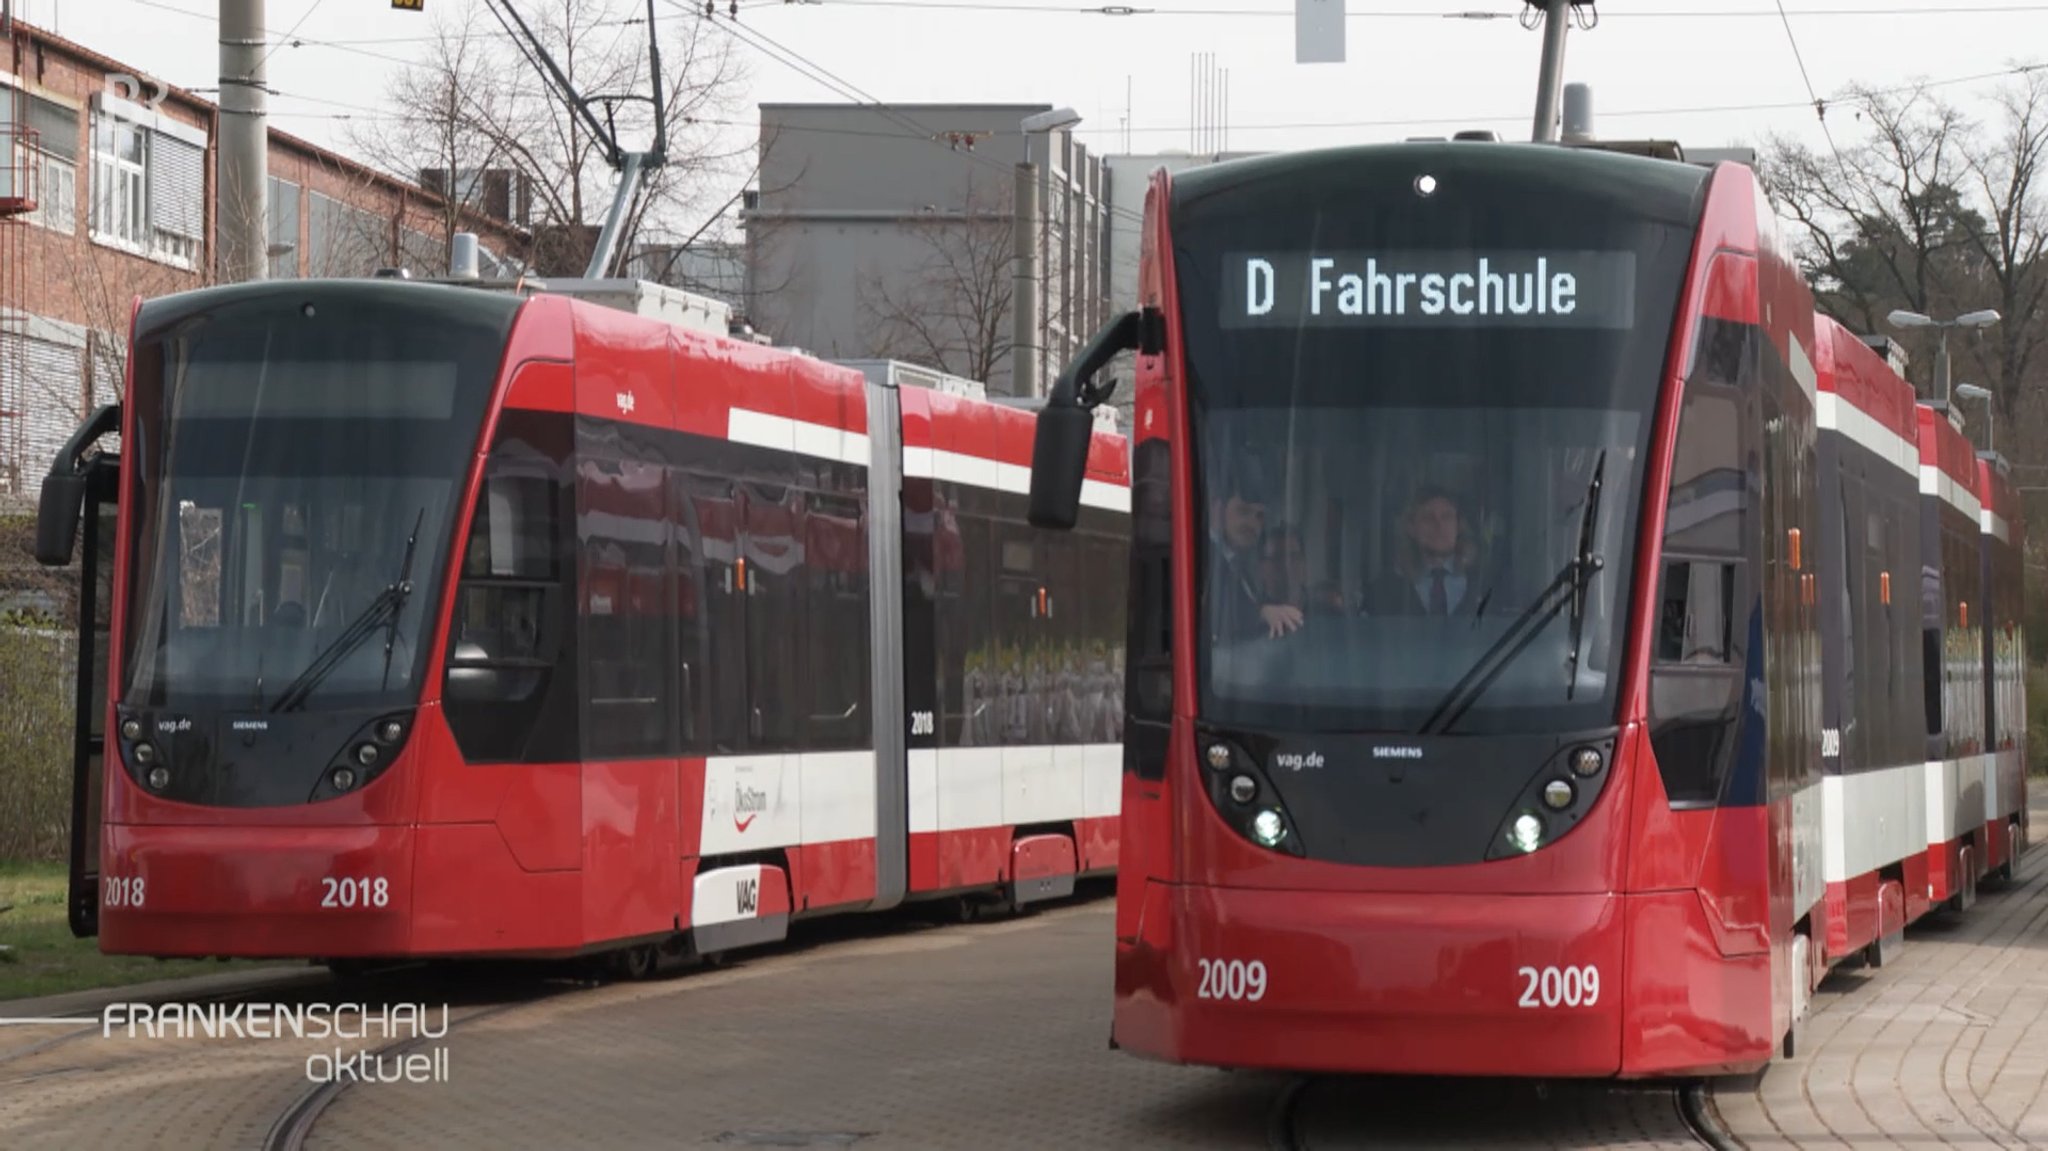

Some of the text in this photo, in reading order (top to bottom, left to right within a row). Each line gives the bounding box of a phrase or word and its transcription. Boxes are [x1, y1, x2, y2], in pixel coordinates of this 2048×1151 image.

[1247, 256, 1576, 315] D Fahrschule
[159, 717, 192, 733] vag.de
[232, 720, 268, 730] SIEMENS
[911, 710, 934, 735] 2018
[1372, 746, 1423, 759] SIEMENS
[1821, 727, 1840, 757] 2009
[1276, 752, 1325, 771] vag.de
[104, 876, 145, 907] 2018
[320, 877, 389, 908] 2018
[736, 878, 756, 914] VAG
[1197, 958, 1267, 1001] 2009
[1518, 964, 1600, 1008] 2009
